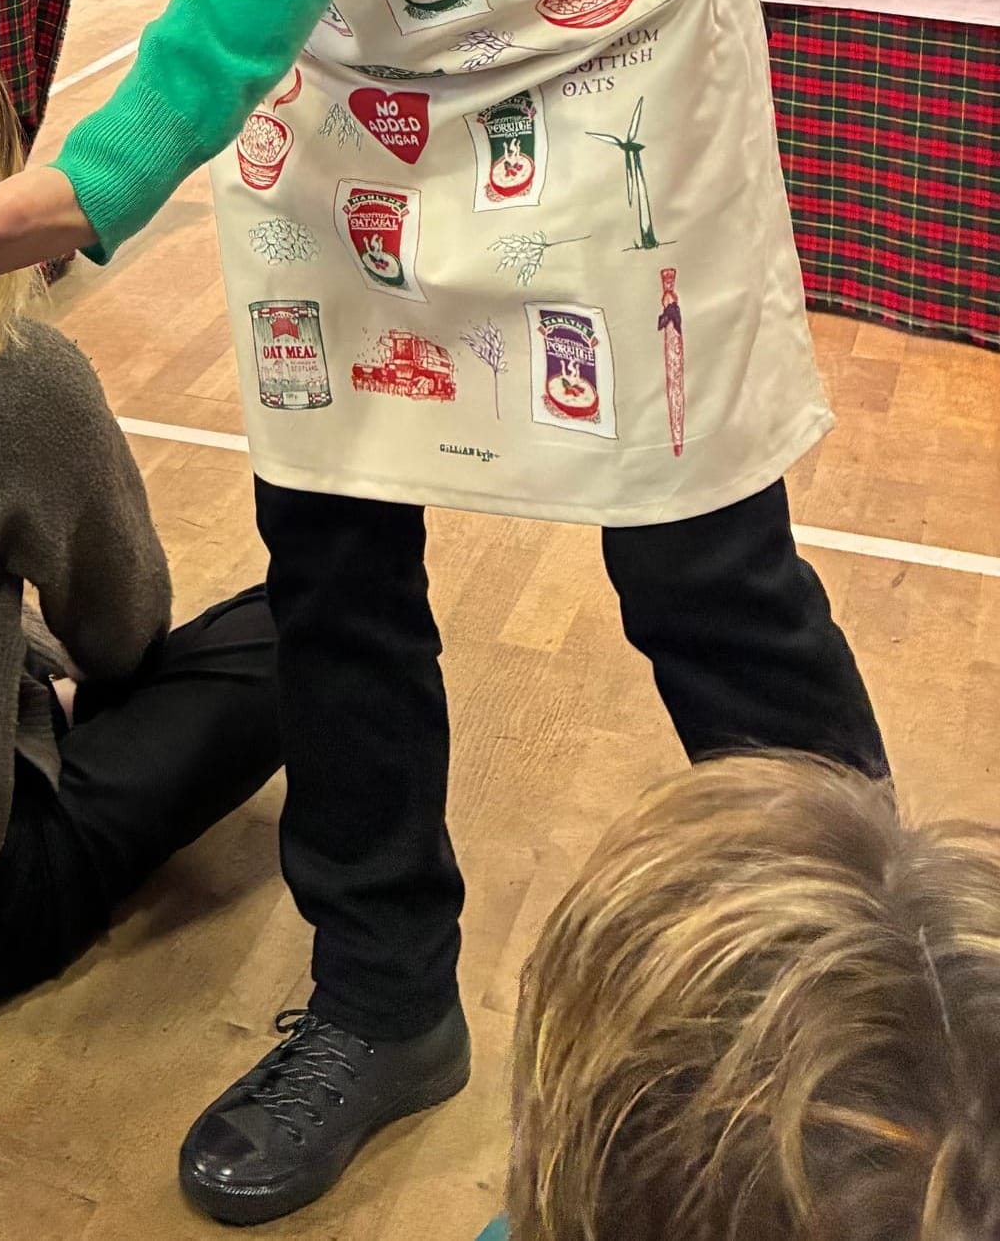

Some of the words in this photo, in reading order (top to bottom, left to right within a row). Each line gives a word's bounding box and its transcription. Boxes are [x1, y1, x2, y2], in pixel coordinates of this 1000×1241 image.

[562, 76, 616, 97] OATS
[375, 100, 399, 117] NO
[368, 116, 421, 133] ADDED
[381, 133, 420, 147] SUGAR
[350, 217, 399, 229] OATMEAL
[262, 345, 283, 360] OAT
[284, 345, 318, 360] MEAL
